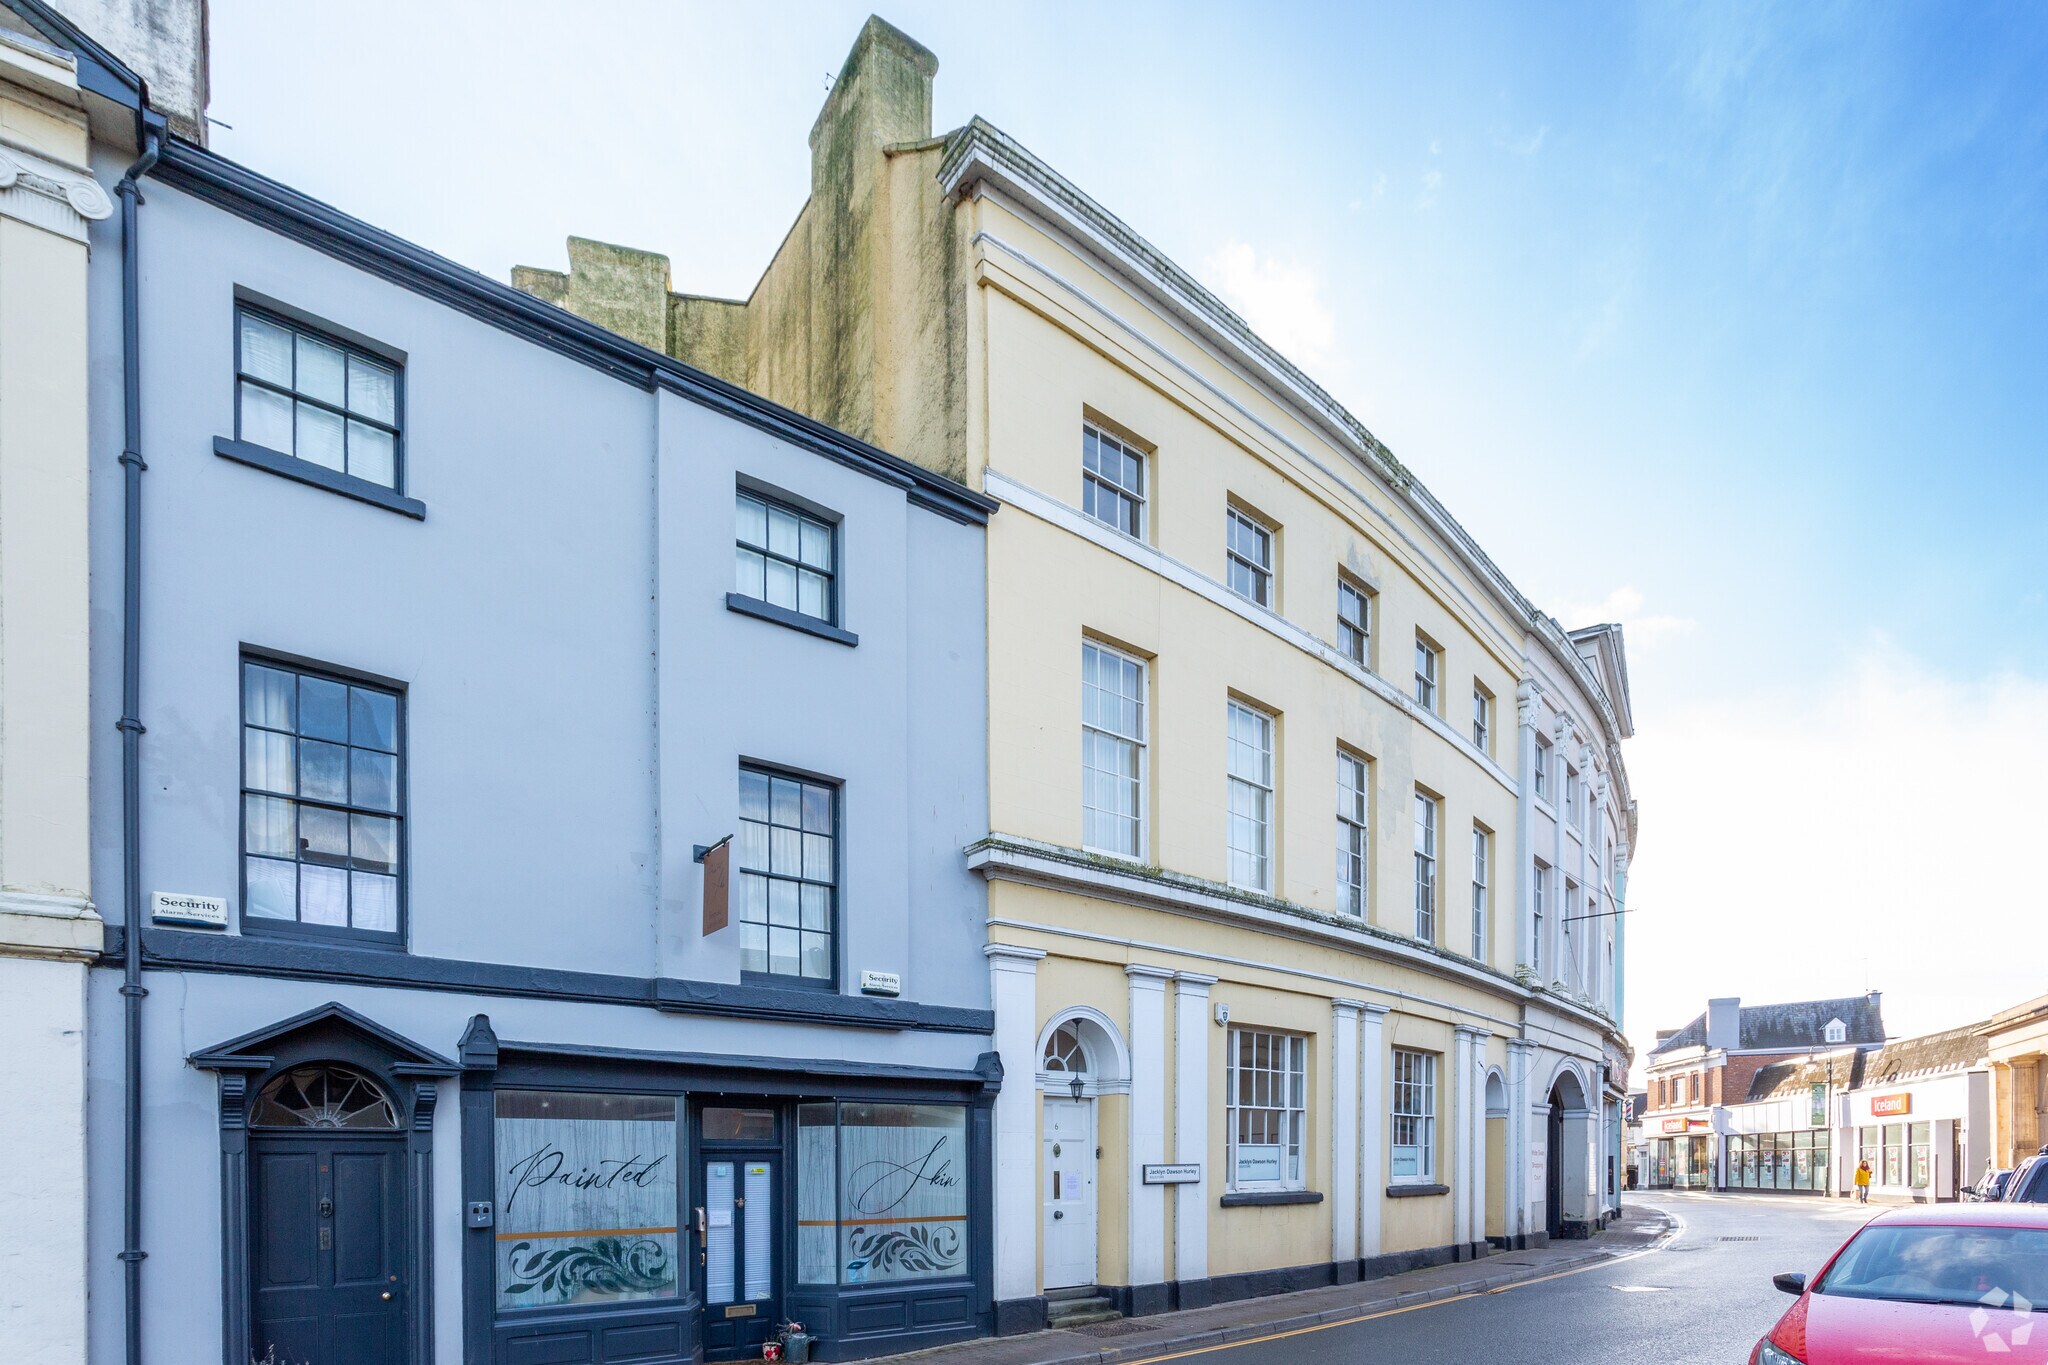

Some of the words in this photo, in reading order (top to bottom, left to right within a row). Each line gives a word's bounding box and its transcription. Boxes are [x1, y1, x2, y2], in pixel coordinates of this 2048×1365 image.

[160, 896, 220, 912] Security
[187, 911, 220, 919] Services
[868, 974, 899, 984] Security
[1874, 1097, 1902, 1113] Iceland
[1054, 1122, 1059, 1131] 6
[1664, 1120, 1683, 1131] Iceland
[506, 1142, 668, 1214] Painted
[847, 1135, 961, 1215] Skin
